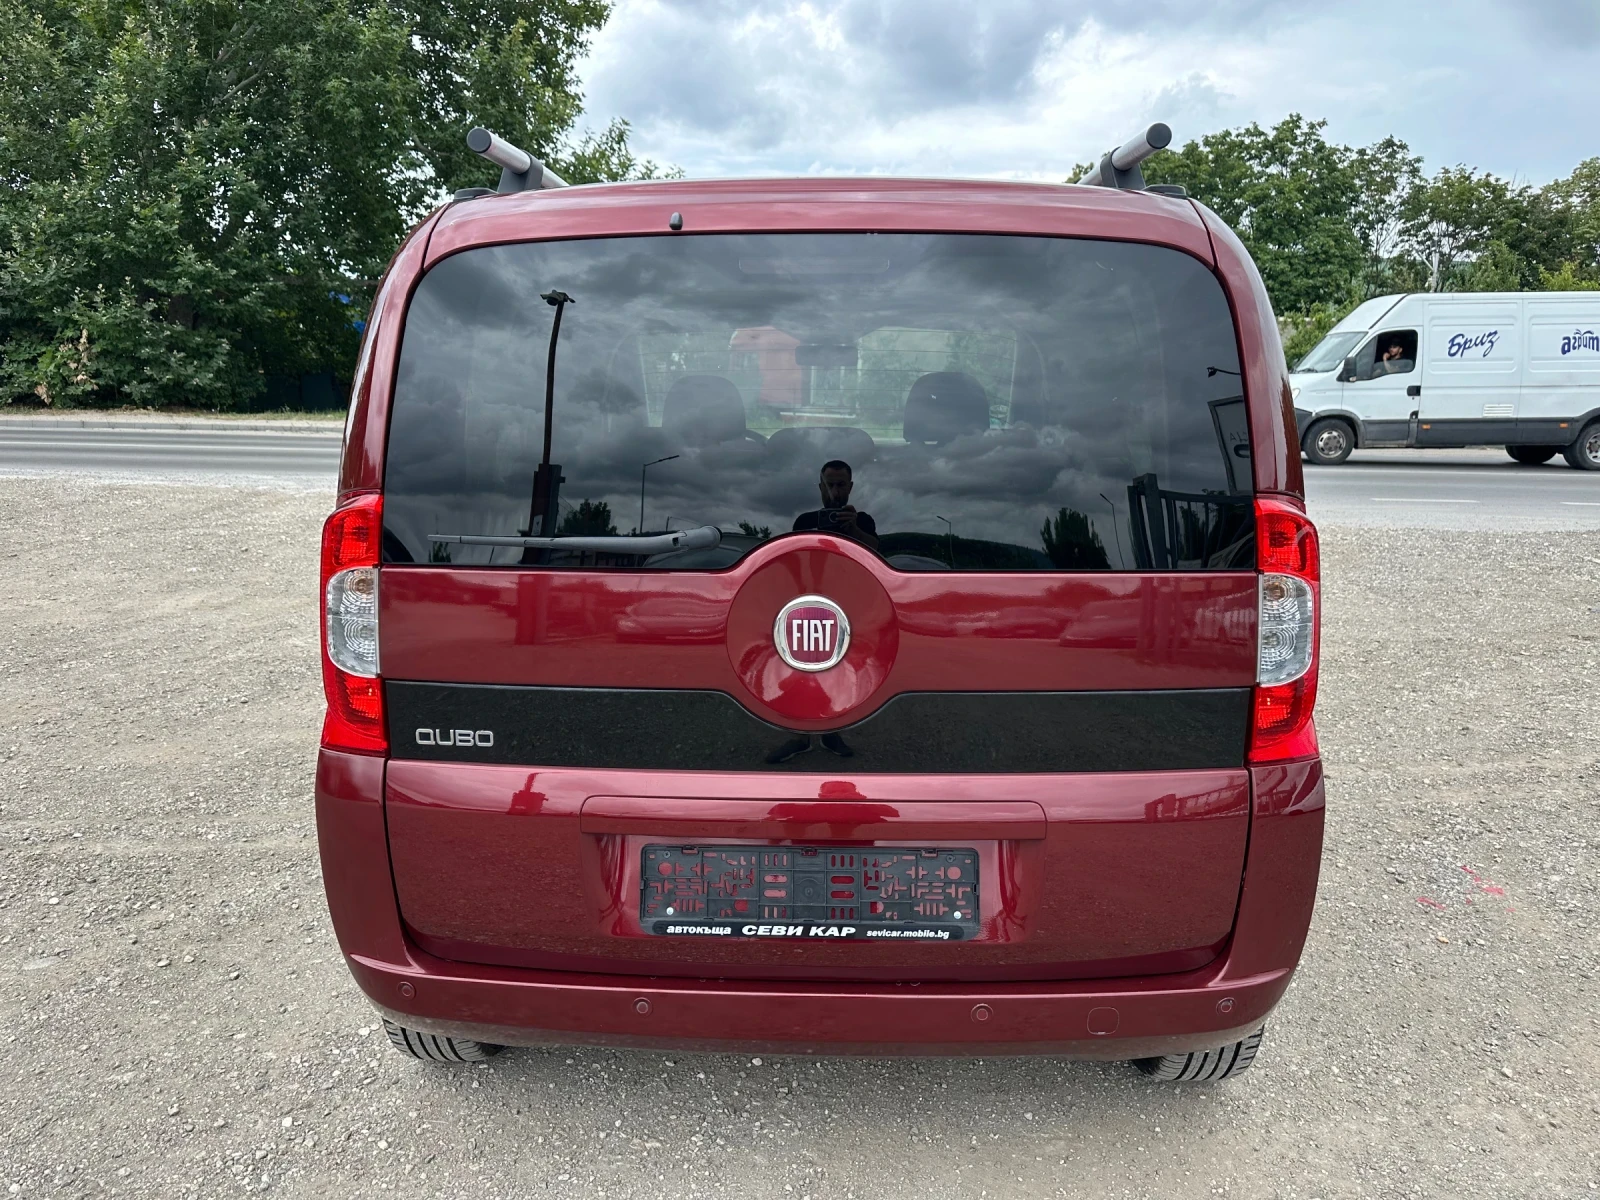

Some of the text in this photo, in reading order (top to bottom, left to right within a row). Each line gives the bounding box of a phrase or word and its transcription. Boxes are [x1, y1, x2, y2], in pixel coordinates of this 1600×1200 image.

[1448, 330, 1500, 358] Бриз
[792, 619, 834, 651] FIAT
[415, 728, 494, 747] QUBO
[666, 925, 950, 940] автокъща СЕВИ КАР sevicar.mobile.bg
